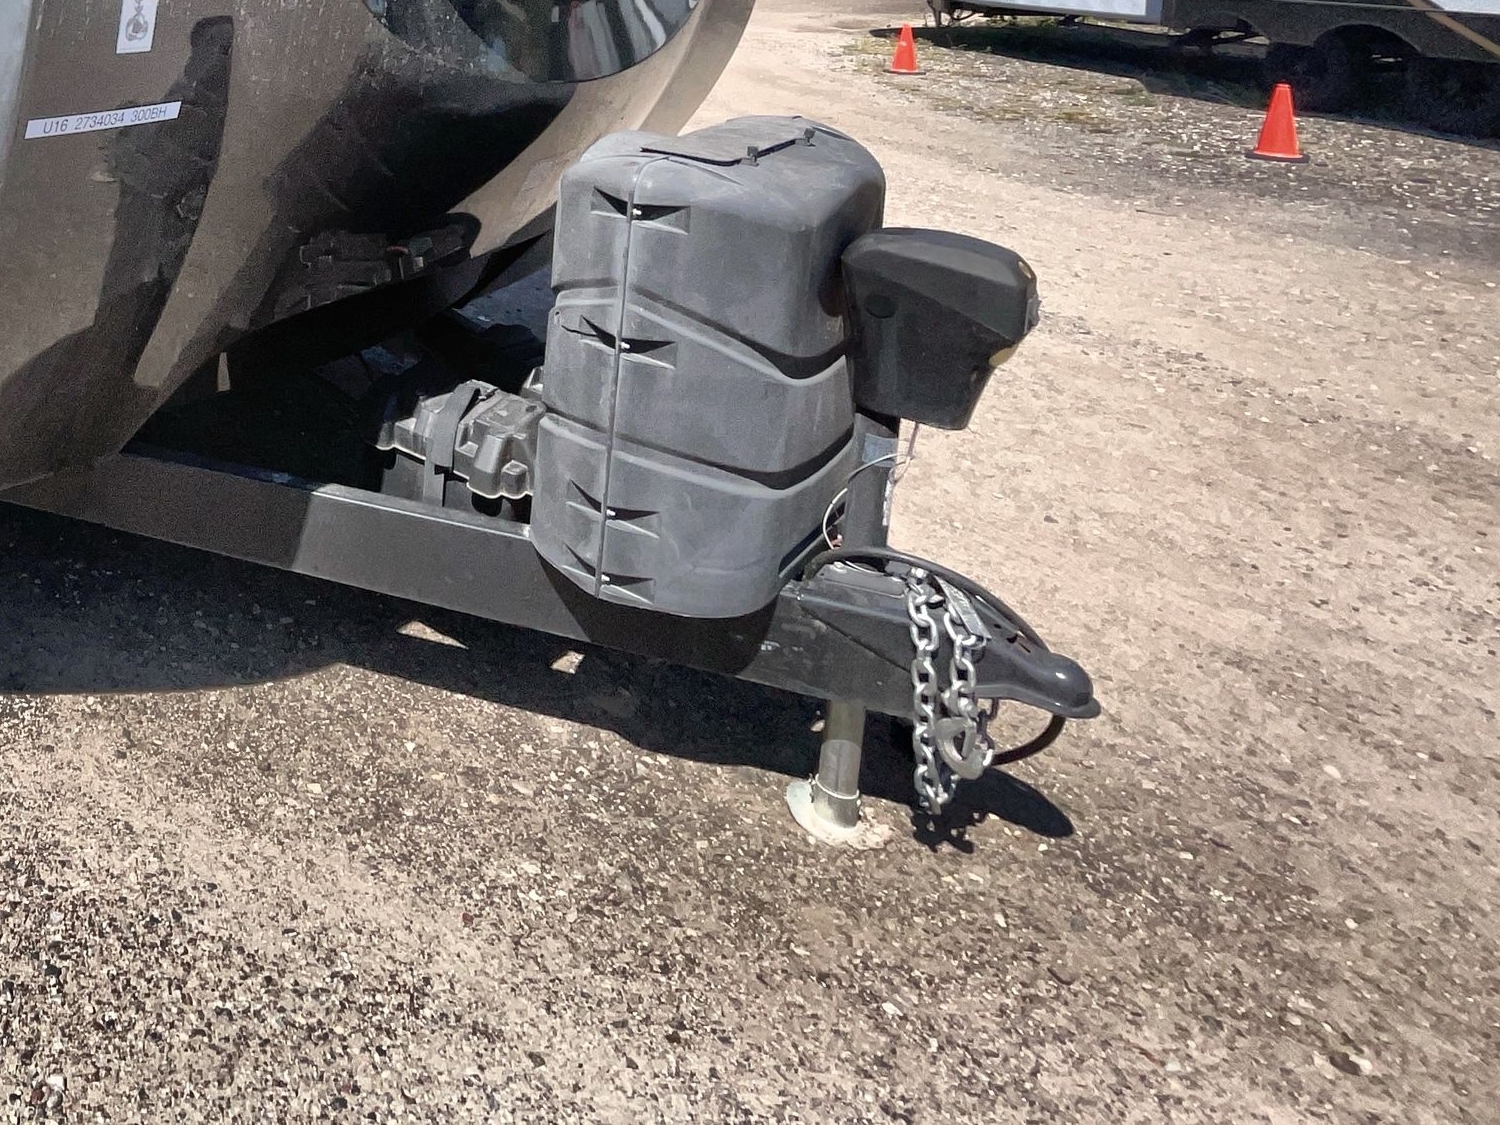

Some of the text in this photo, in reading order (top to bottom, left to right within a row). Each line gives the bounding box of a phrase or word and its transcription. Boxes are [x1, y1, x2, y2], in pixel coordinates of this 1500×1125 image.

[43, 106, 168, 134] U16 2734034 300BH
